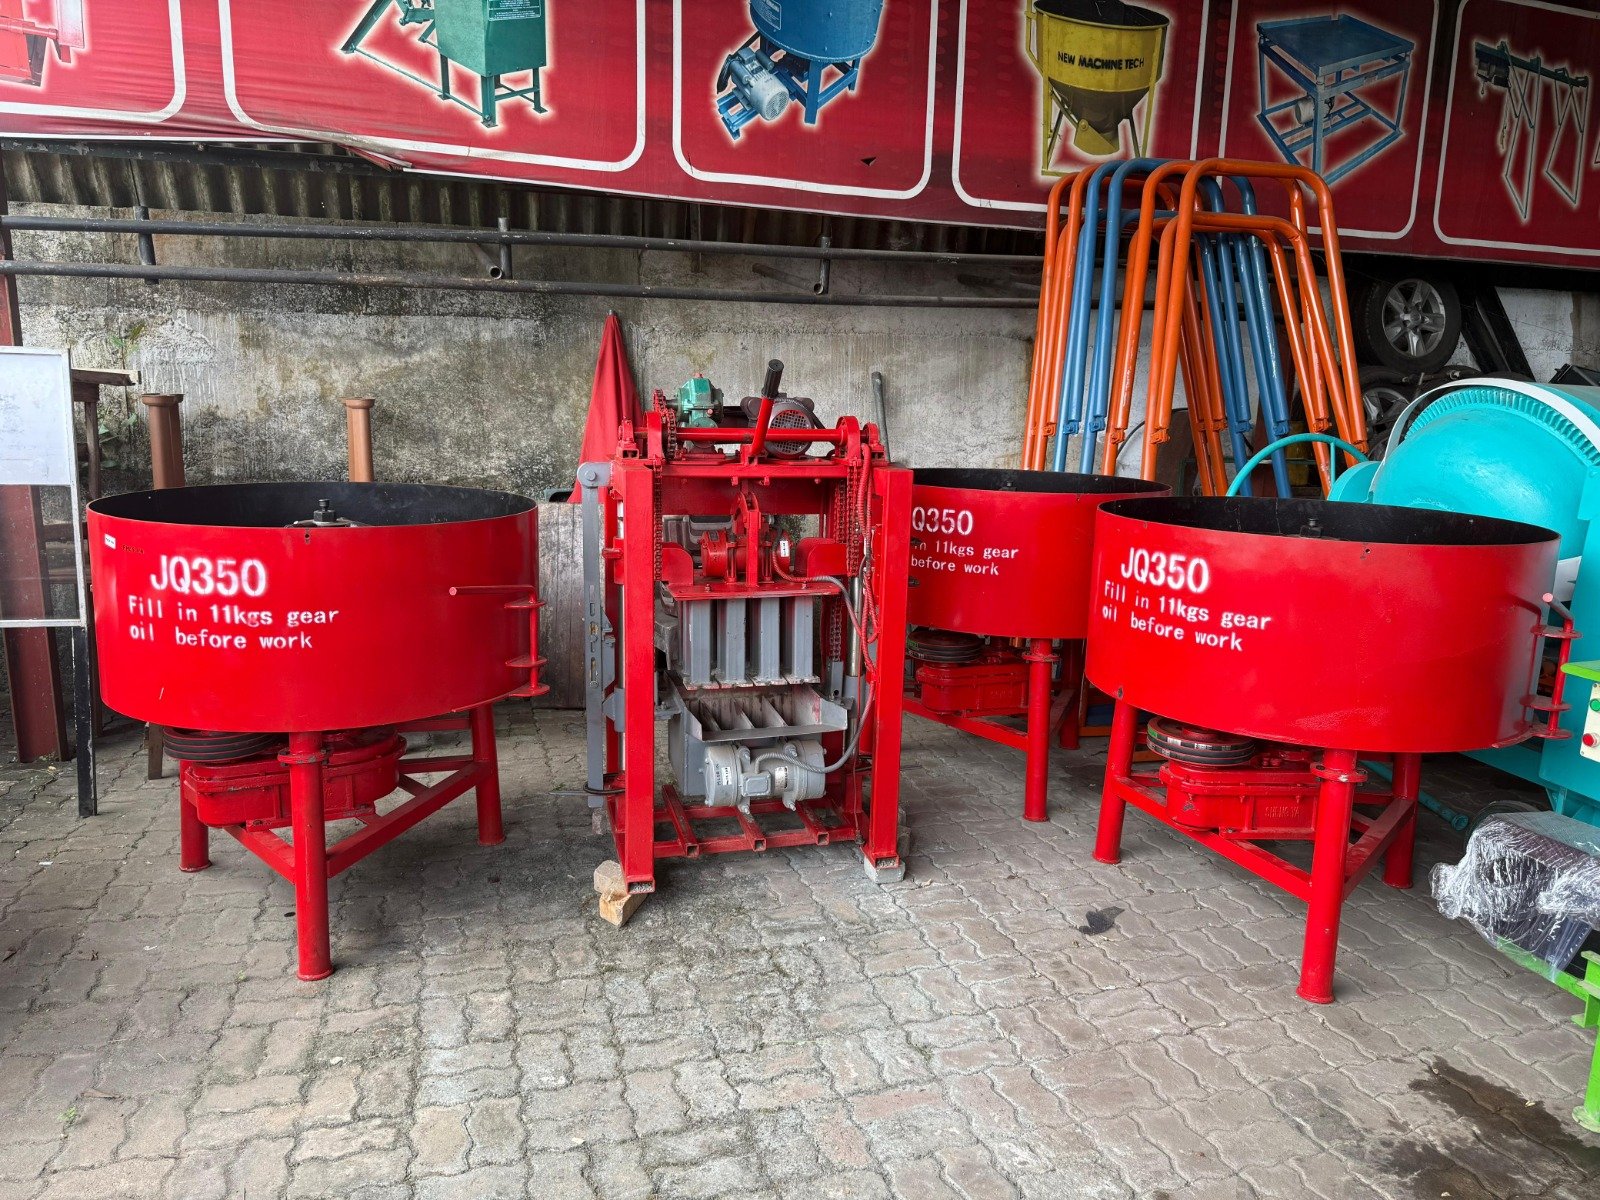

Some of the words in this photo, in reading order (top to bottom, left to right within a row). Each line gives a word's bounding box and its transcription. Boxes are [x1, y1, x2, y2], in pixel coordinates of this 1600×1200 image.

[1057, 51, 1076, 65] NEW
[1078, 55, 1123, 70] MACHINE
[1124, 57, 1145, 70] TECH
[911, 554, 956, 572] before
[963, 562, 999, 576] work
[935, 540, 975, 557] 11kgs
[982, 547, 1020, 560] gear
[150, 554, 267, 597] JQ350
[1120, 546, 1210, 594] JQ350
[128, 594, 163, 619] Fill
[177, 601, 198, 622] in
[209, 603, 273, 628] 11kgs
[286, 608, 340, 628] gear
[1104, 579, 1126, 603] Fill
[1134, 589, 1150, 610] in
[1159, 595, 1210, 623] 11kgs
[1219, 610, 1272, 631] gear
[129, 621, 155, 642] oil
[174, 625, 248, 650] before
[258, 631, 313, 650] work
[1102, 604, 1118, 623] oil
[1130, 611, 1185, 641] before
[1194, 630, 1243, 652] work
